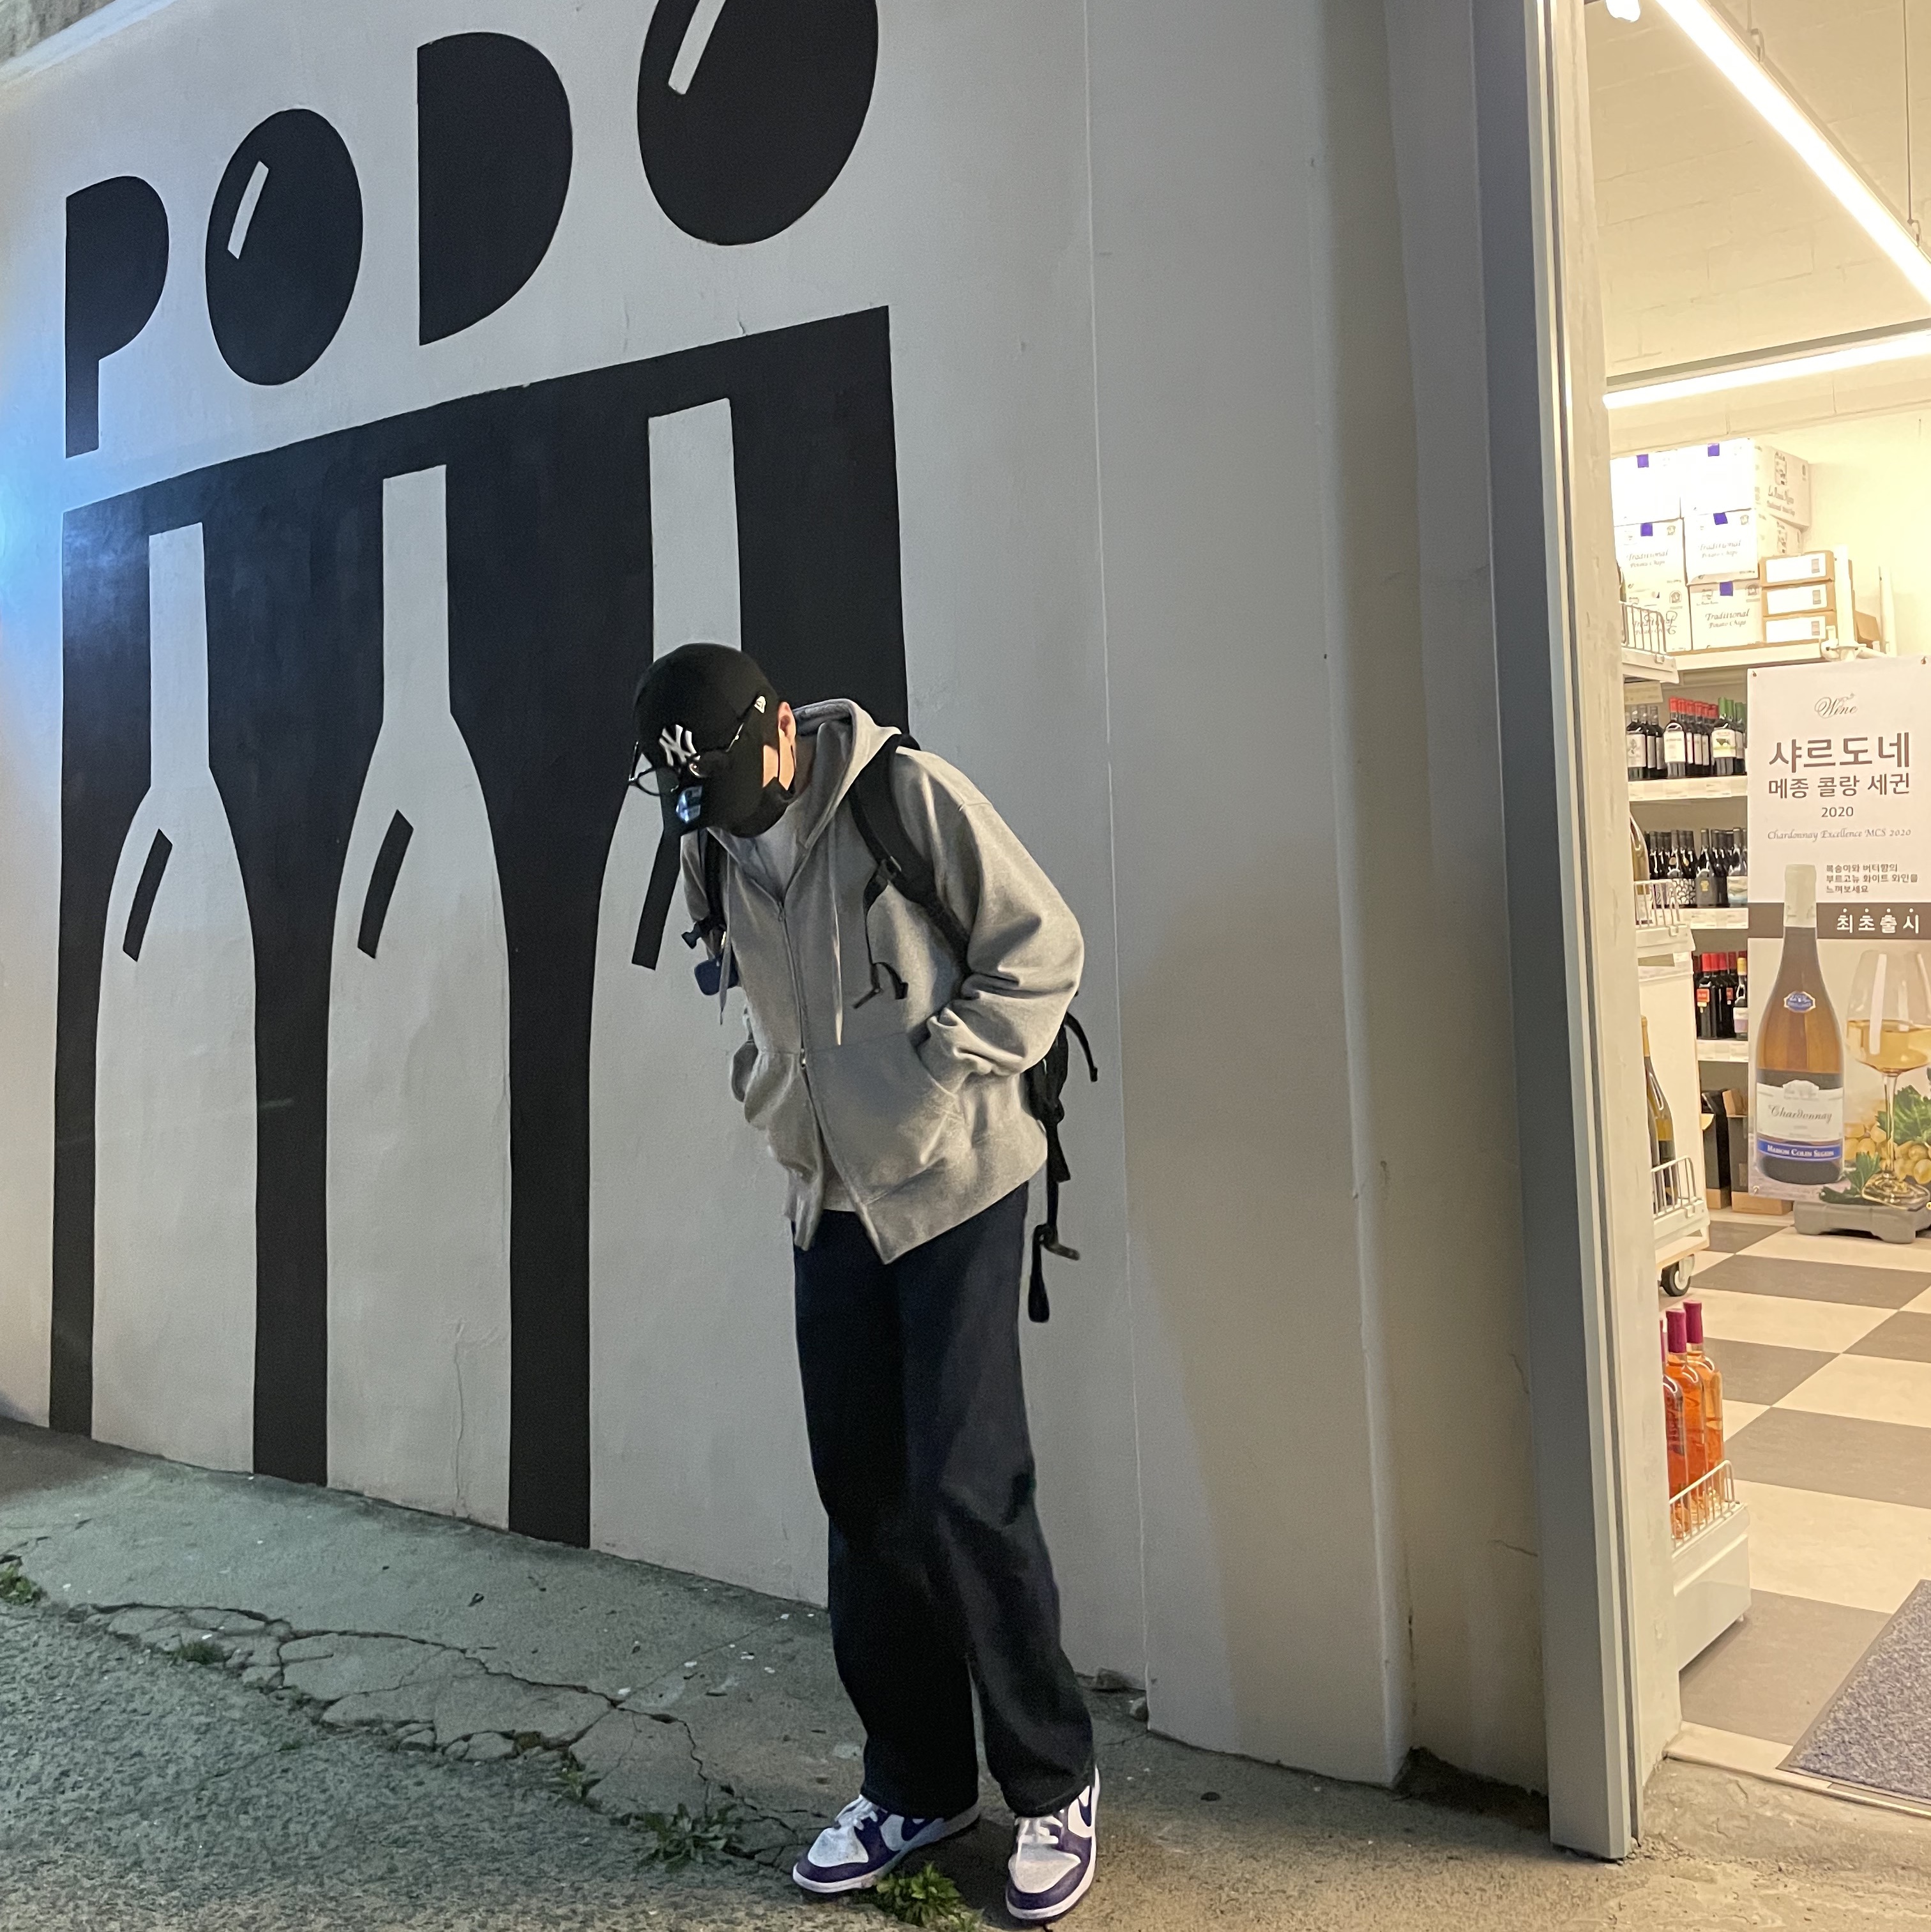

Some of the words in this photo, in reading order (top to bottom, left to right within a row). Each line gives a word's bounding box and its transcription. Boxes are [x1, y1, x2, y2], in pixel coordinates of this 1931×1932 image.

[65, 0, 879, 459] PODO
[1705, 608, 1750, 621] Traditional
[1814, 692, 1859, 719] Wine
[1768, 731, 1910, 773] 샤르도네
[1768, 777, 1810, 800] 메종
[1817, 775, 1860, 798] 콜랑
[1867, 772, 1911, 795] 세귄
[1821, 805, 1854, 818] 2020
[1767, 828, 1819, 842] Chardonnay
[1821, 827, 1863, 839] Excellence
[1864, 828, 1887, 837] MCS
[1889, 828, 1912, 837] 2020
[1768, 1104, 1833, 1124] Chardonnay
